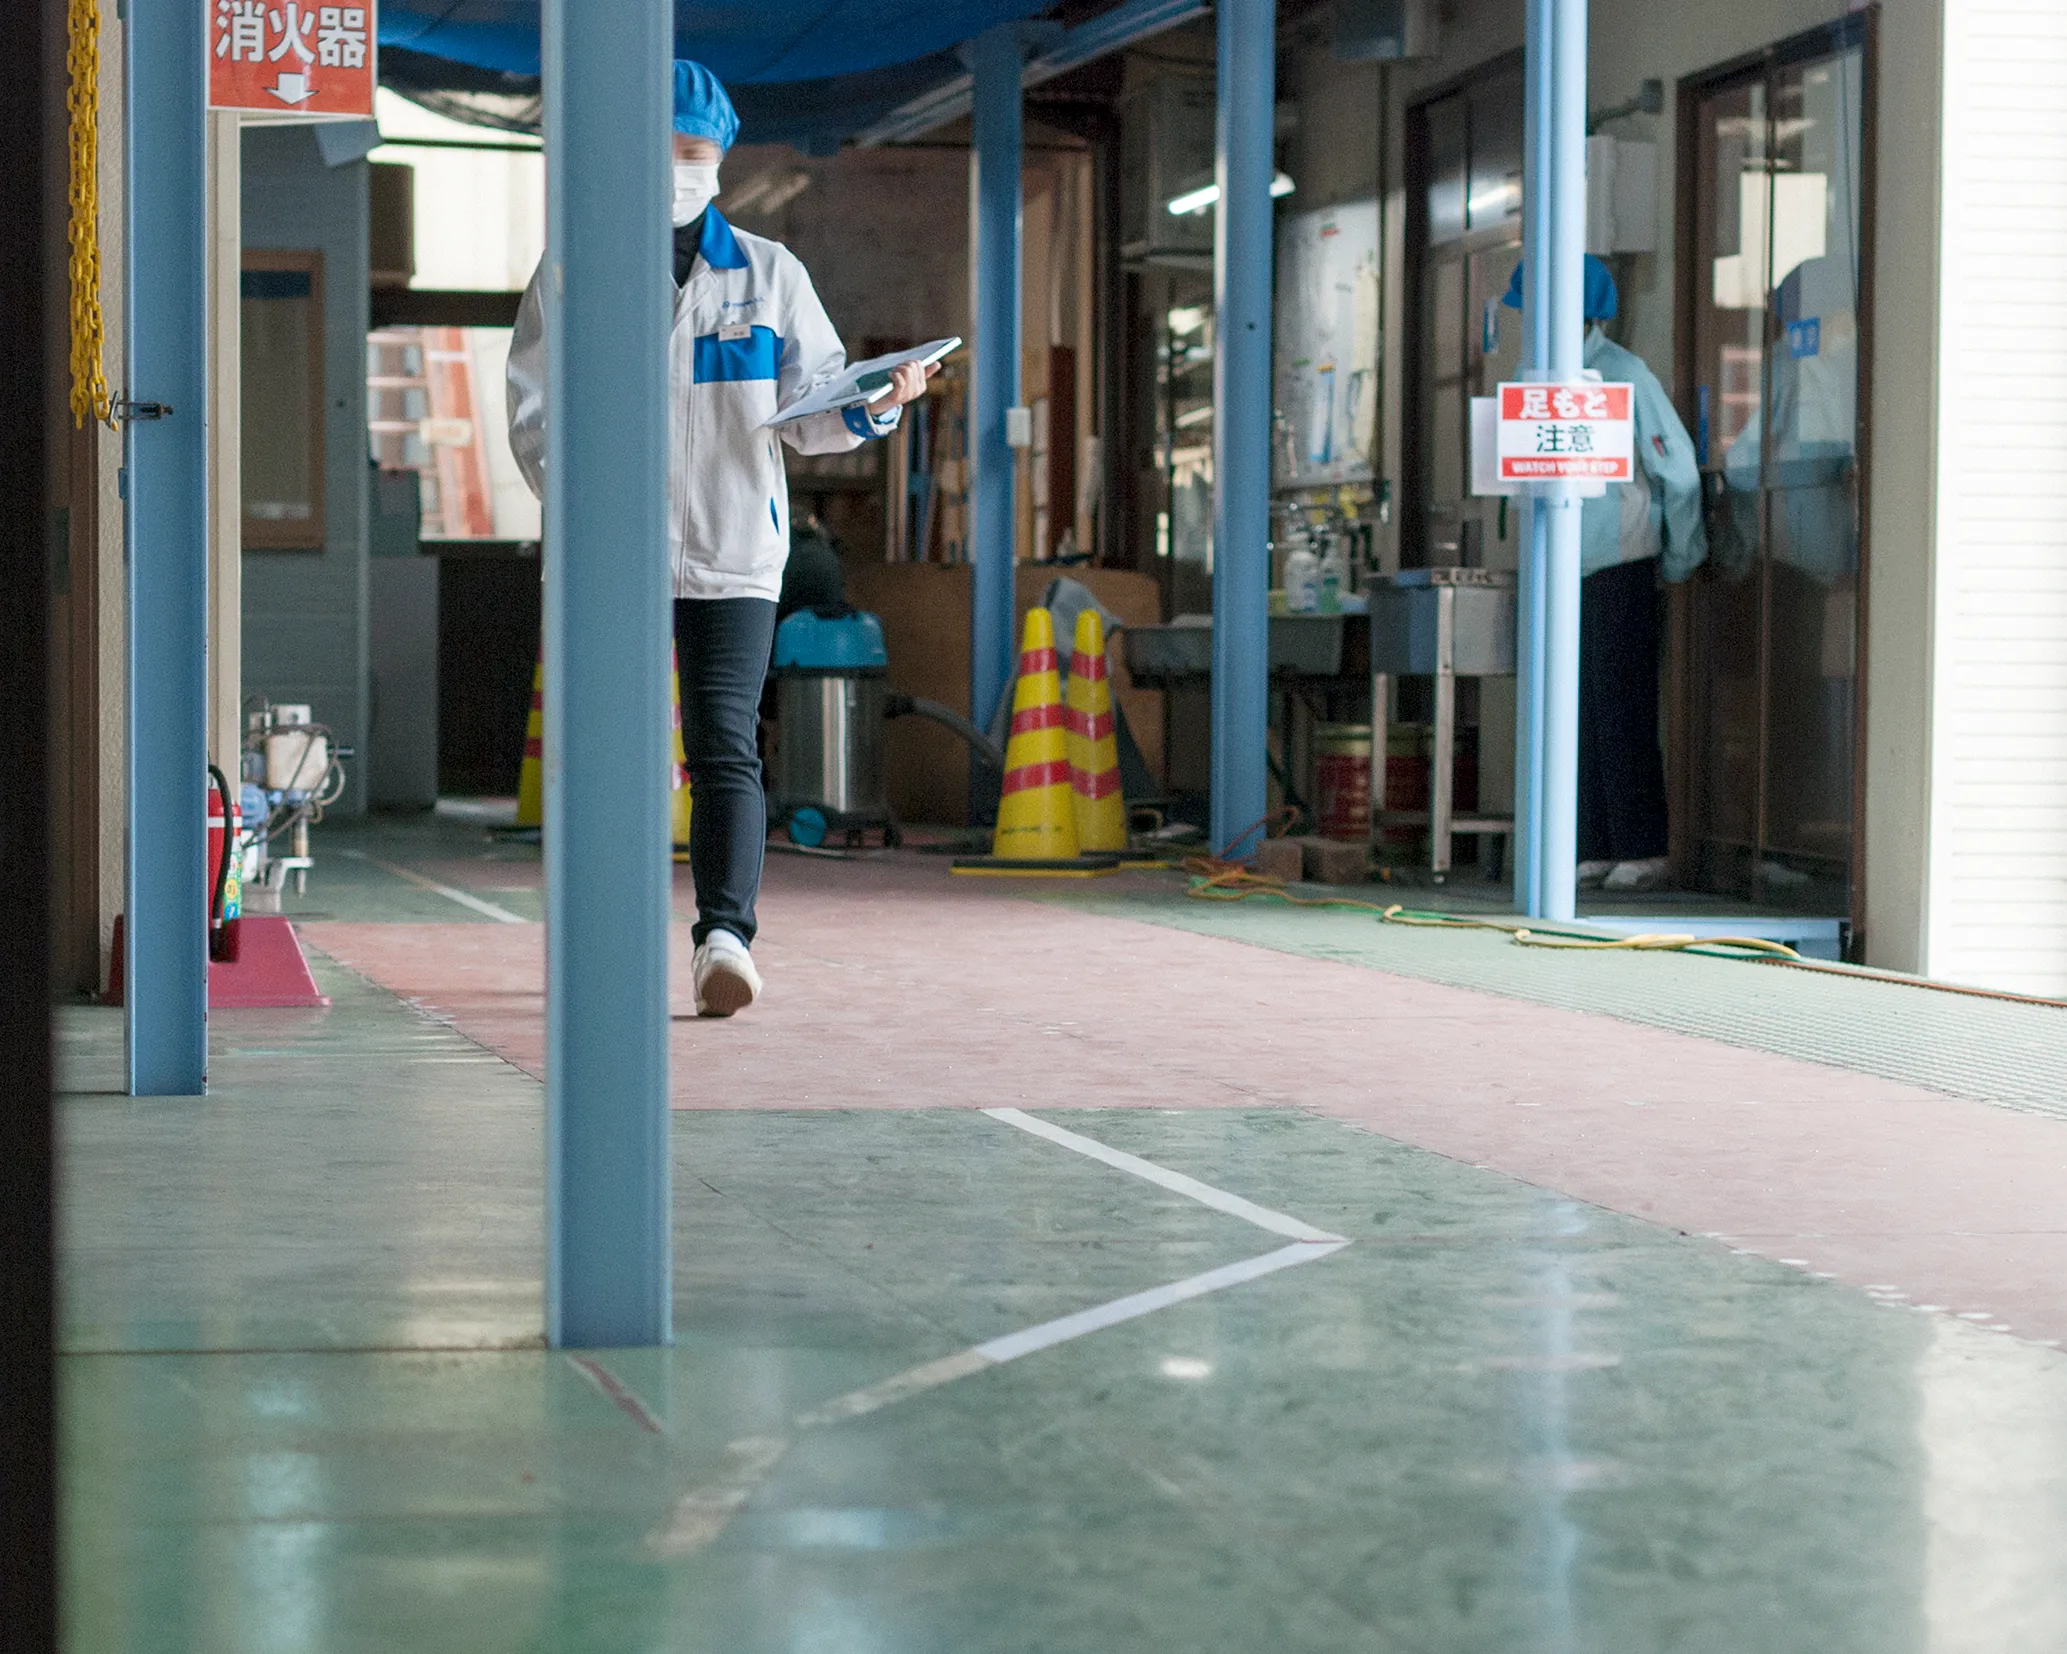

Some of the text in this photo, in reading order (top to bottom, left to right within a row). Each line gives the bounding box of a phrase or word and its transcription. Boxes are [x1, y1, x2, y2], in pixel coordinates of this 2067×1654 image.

[215, 0, 366, 68] 消火器
[1520, 388, 1607, 419] 足もと
[1536, 424, 1594, 452] 注意
